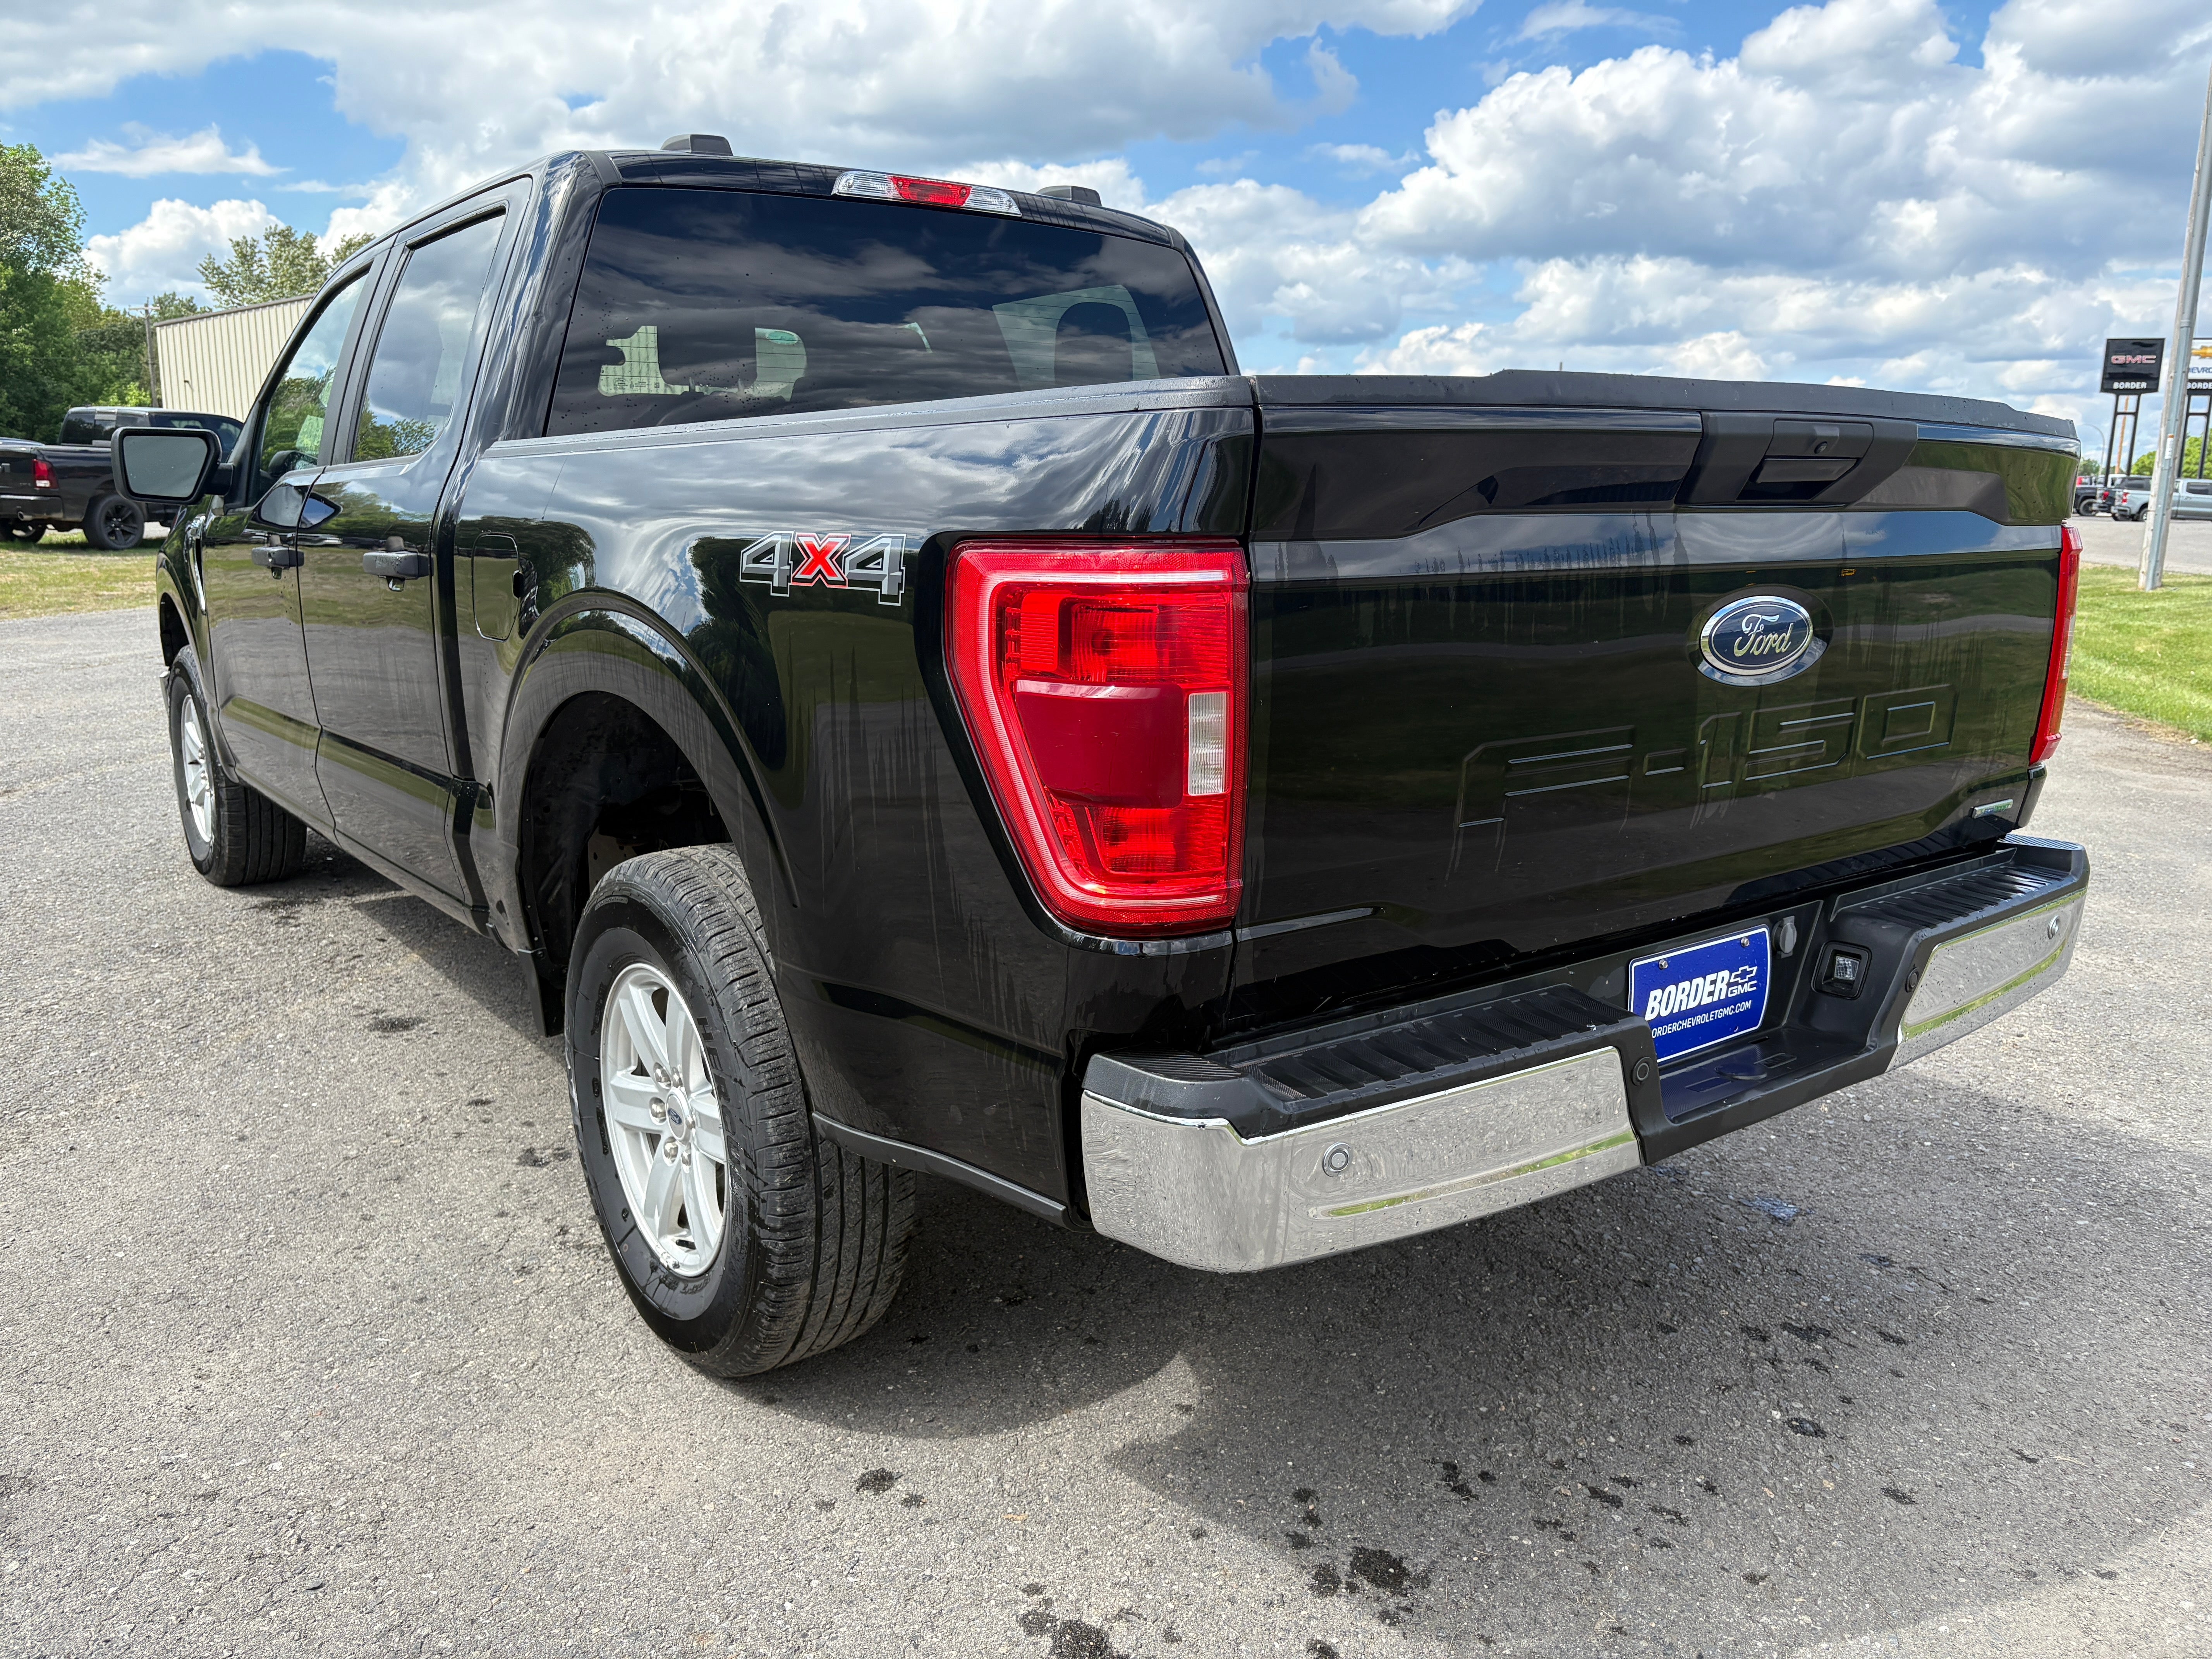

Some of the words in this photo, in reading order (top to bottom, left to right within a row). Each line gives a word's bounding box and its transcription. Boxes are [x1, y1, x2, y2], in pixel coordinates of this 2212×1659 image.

[2111, 355, 2156, 364] GMC
[1733, 613, 1794, 657] Ford
[1457, 683, 1959, 828] F-150
[1644, 970, 1730, 1021] BORDER
[1728, 980, 1758, 998] GMC
[1651, 1000, 1752, 1039] ORDERCHEVROLETGMC.COM
